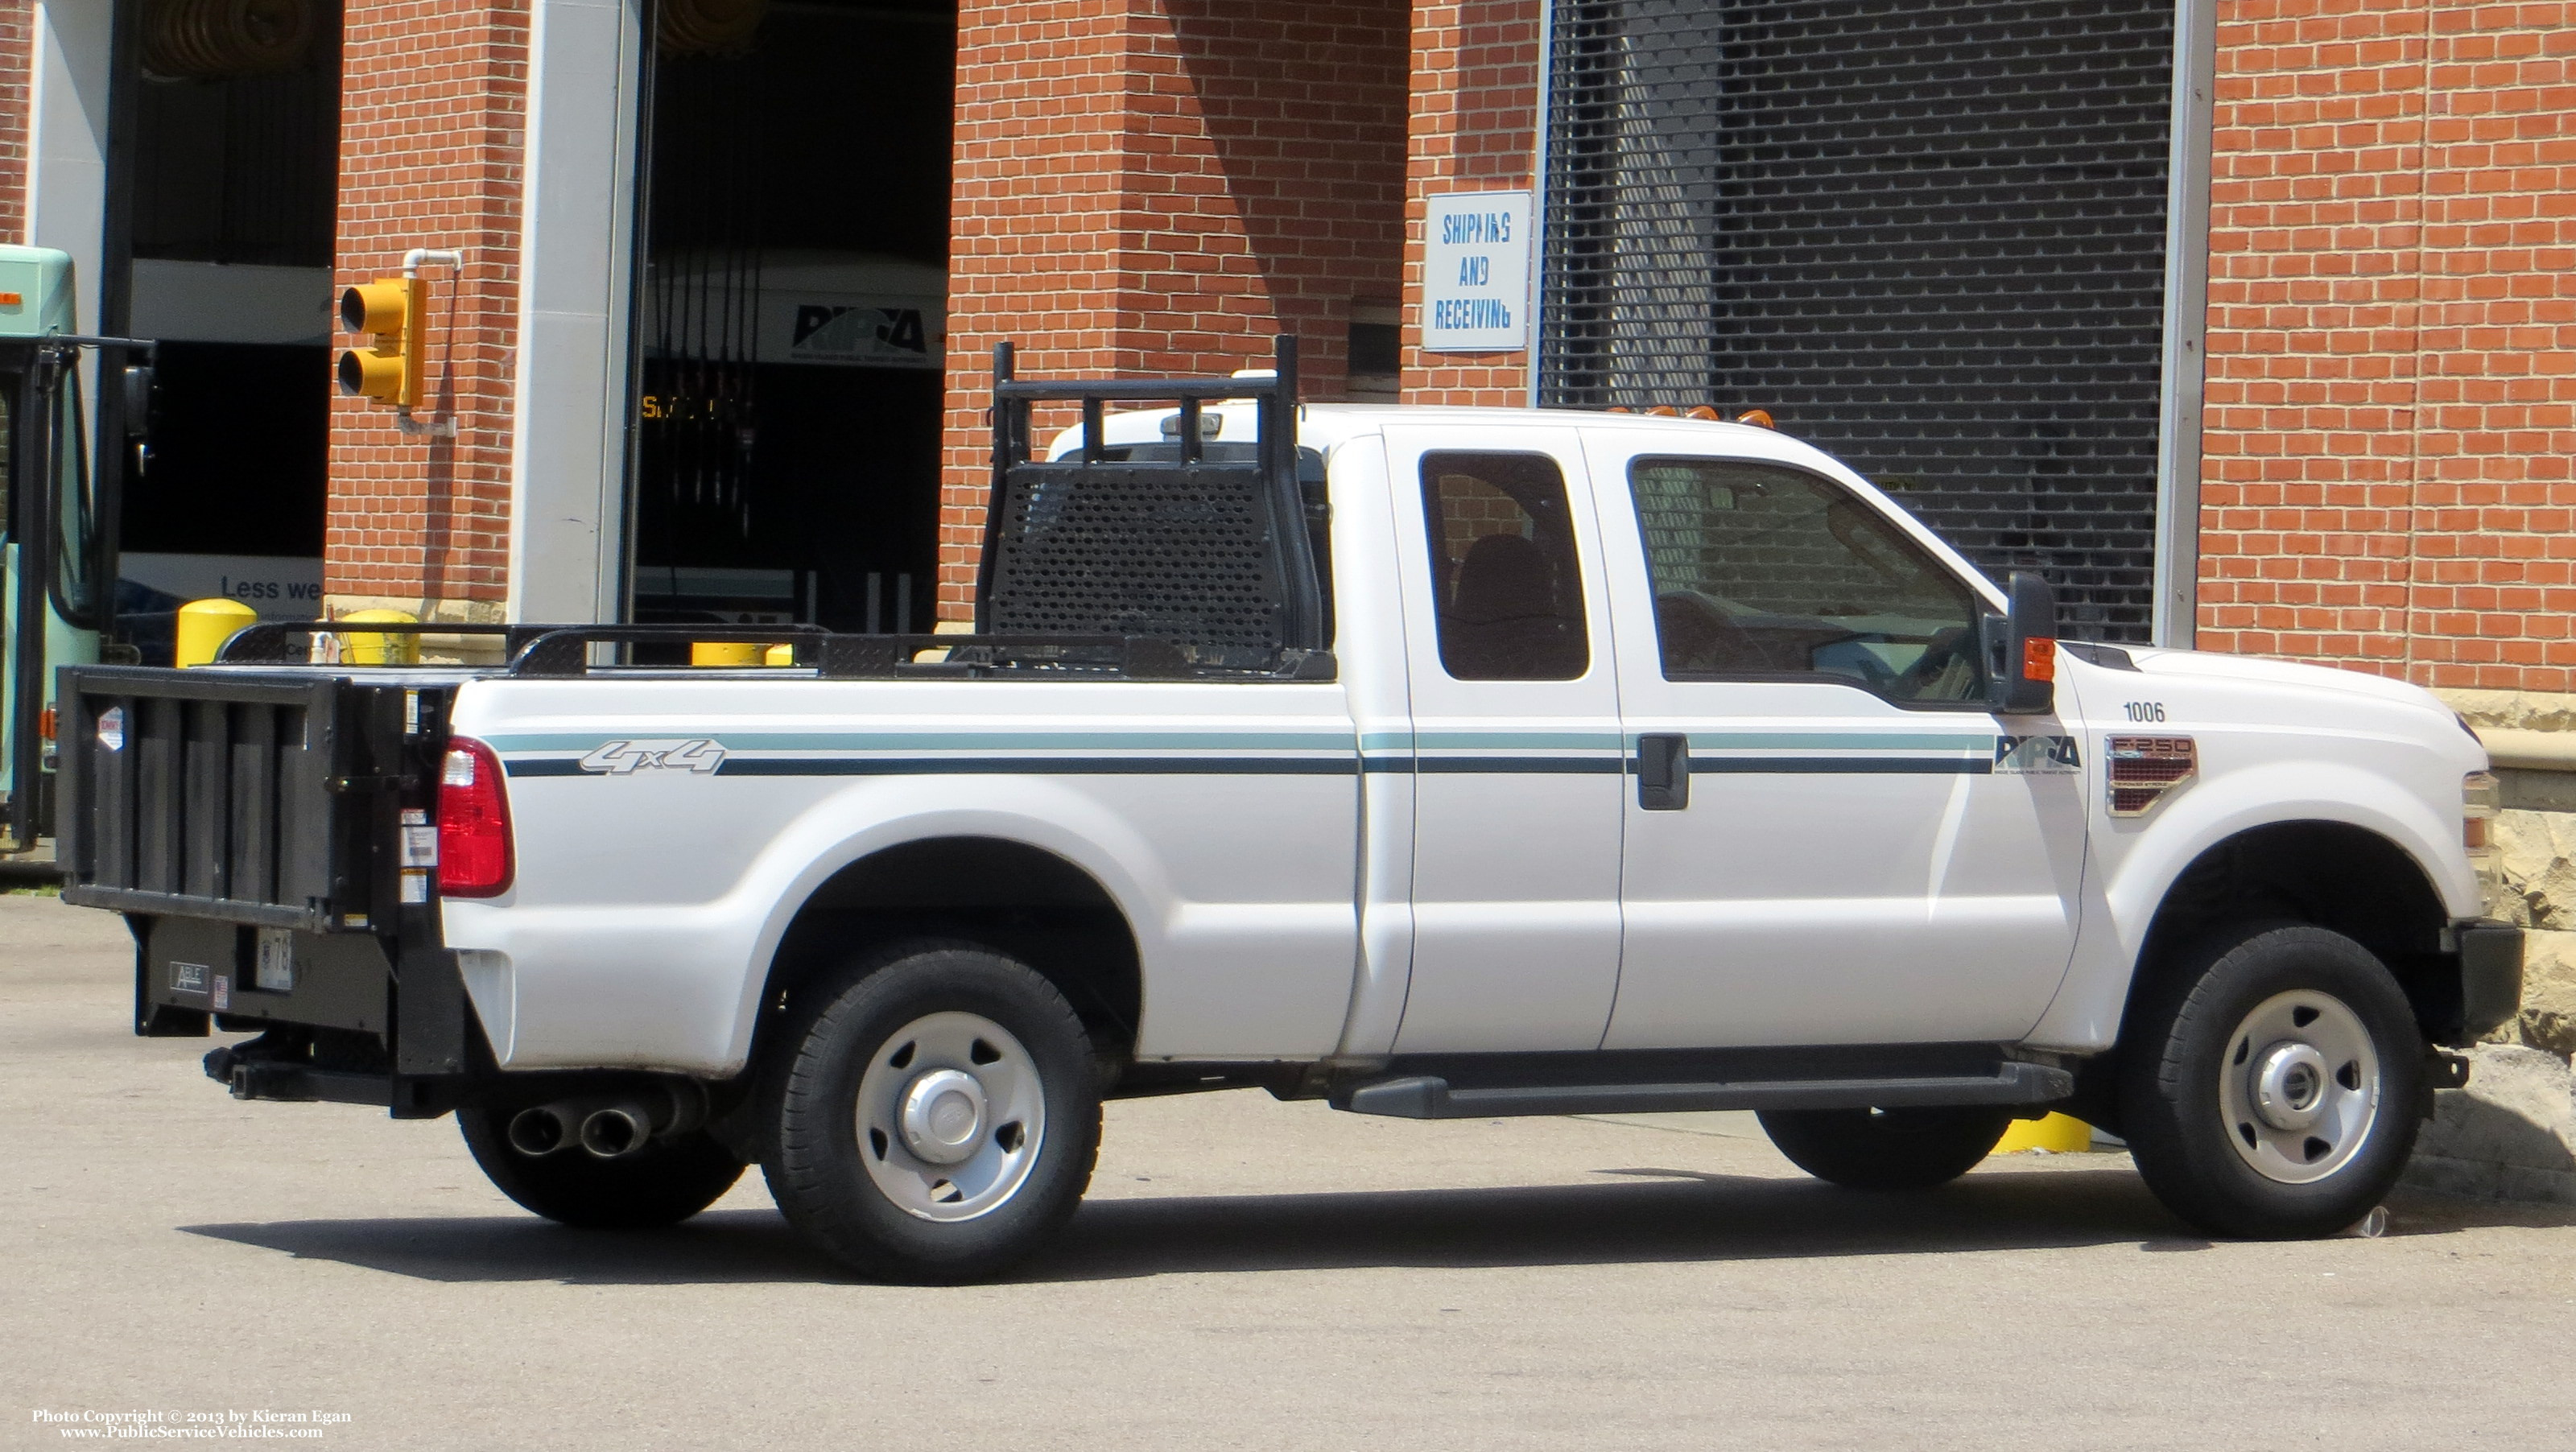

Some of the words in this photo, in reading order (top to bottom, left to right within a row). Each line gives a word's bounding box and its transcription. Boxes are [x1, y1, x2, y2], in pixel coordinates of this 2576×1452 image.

[1459, 256, 1489, 287] AND
[1435, 299, 1511, 330] RECEIVING
[221, 576, 279, 599] Less
[2124, 702, 2165, 722] 1006
[176, 965, 202, 988] ABLE
